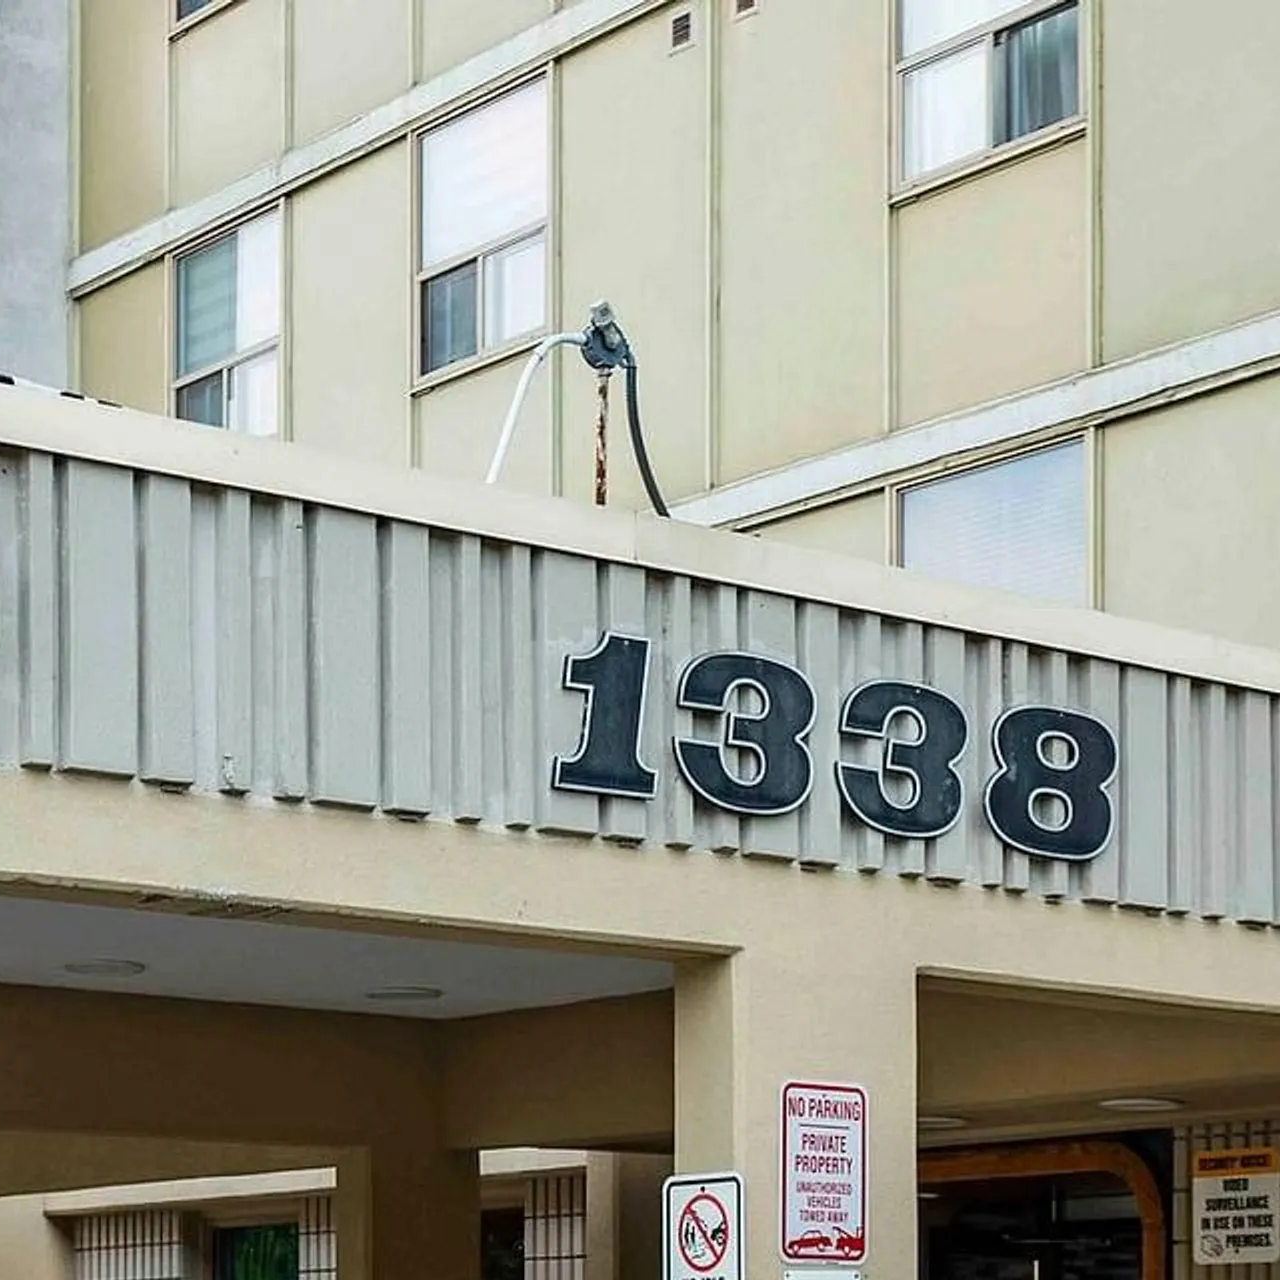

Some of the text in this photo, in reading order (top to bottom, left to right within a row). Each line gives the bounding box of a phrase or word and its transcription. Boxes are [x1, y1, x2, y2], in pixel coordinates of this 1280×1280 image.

[552, 630, 1119, 862] 1338
[788, 1097, 861, 1121] NO PARKING
[802, 1134, 847, 1153] PRIVATE
[795, 1155, 853, 1175] PROPERTY
[796, 1181, 852, 1196] UNAUTHORIZED
[1223, 1178, 1249, 1192] VIDEO
[807, 1197, 841, 1210] VEHICLES
[1205, 1195, 1269, 1212] SURVEILLANCE
[800, 1210, 849, 1223] TOWED AWAY
[1201, 1214, 1274, 1231] IN USE ON THESE
